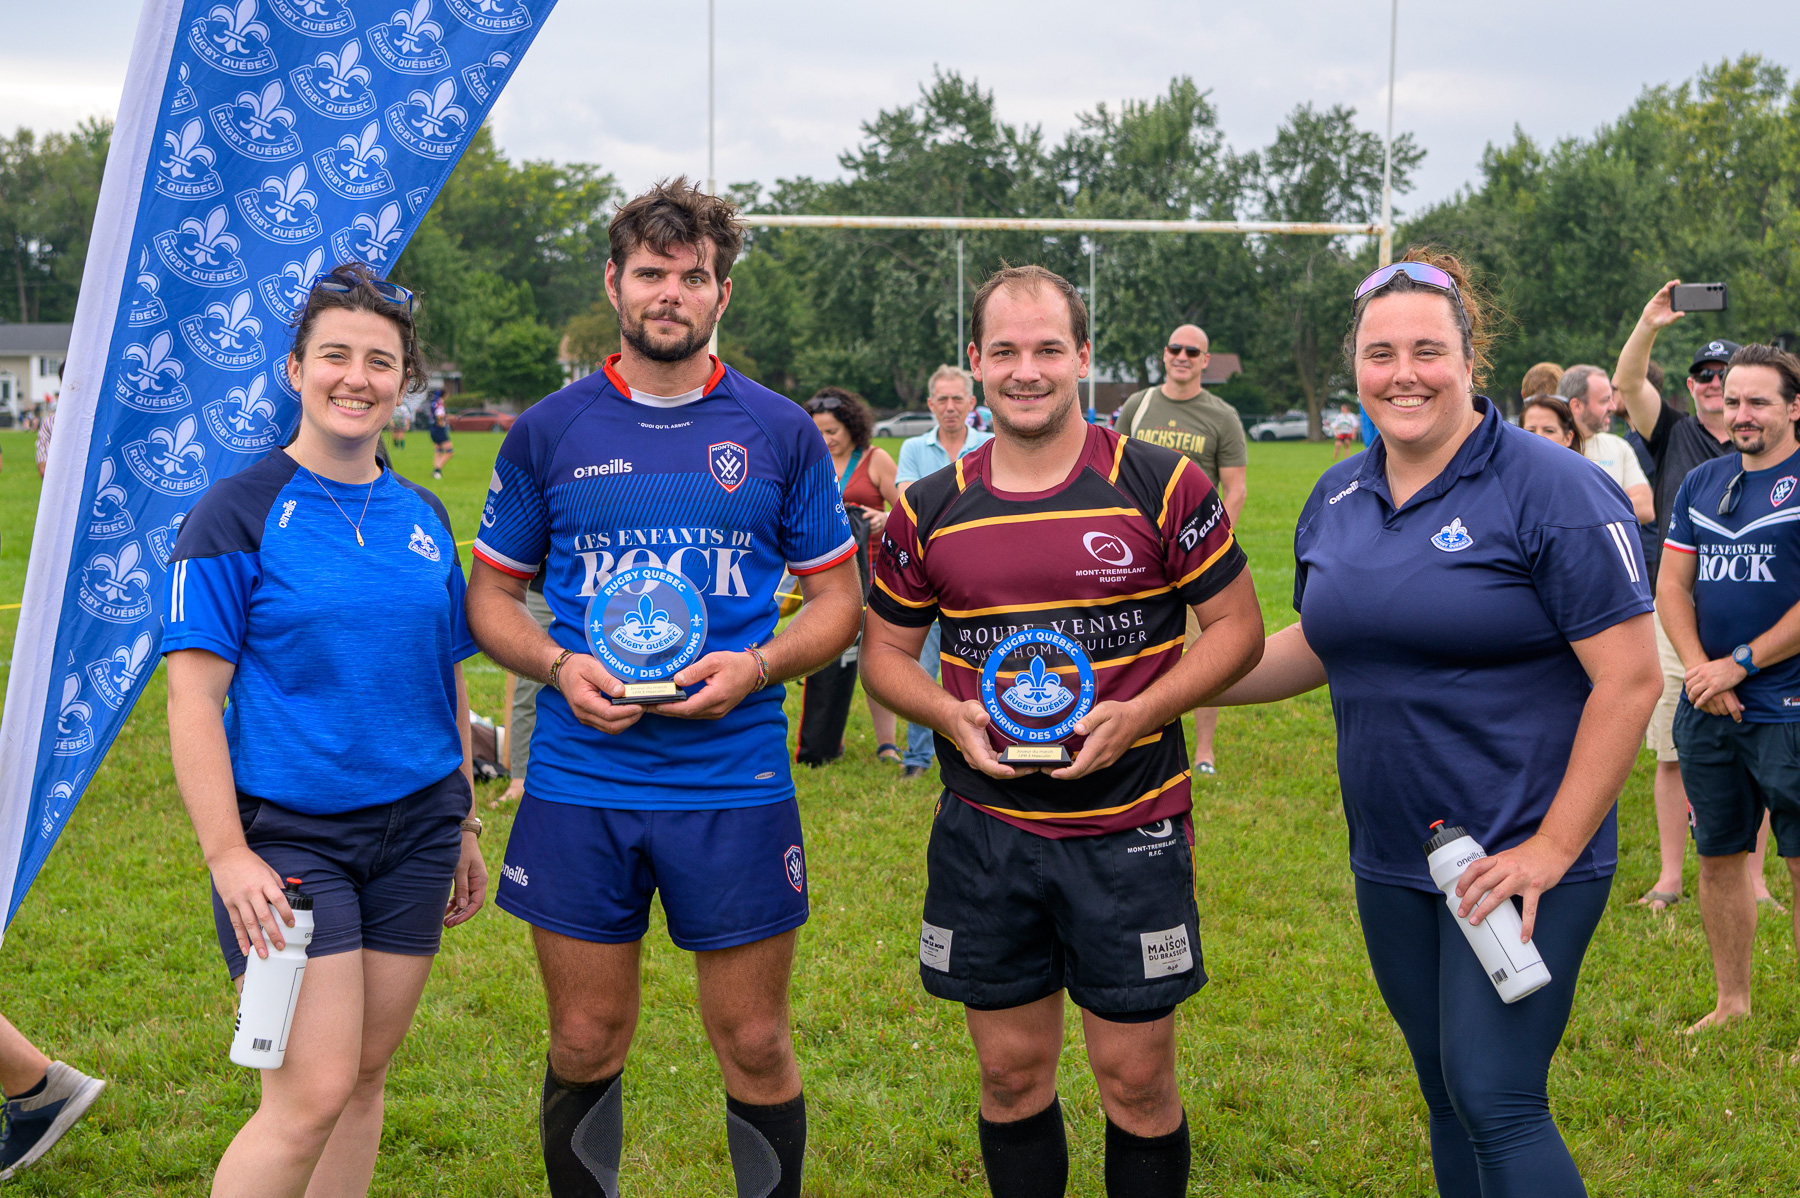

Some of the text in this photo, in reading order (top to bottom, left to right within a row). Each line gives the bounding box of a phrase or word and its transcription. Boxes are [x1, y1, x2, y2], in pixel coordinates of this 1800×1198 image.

[301, 18, 348, 32] QUÉBEC
[476, 17, 524, 28] QUÉBEC
[191, 27, 270, 70] RUGBY QUÉBEC
[372, 31, 443, 69] RUGBY QUÉBEC
[296, 74, 370, 114] RUGBY QUÉBEC
[216, 112, 295, 156] RUGBY QUÉBEC
[389, 110, 418, 144] RUGBY
[167, 181, 216, 195] QUÉBEC
[319, 156, 386, 194] RUGBY QUÉBEC
[242, 197, 316, 238] RUGBY QUÉBEC
[160, 238, 240, 282] RUGBY QUÉBEC
[264, 282, 289, 315] RUGBY
[185, 322, 260, 365] RUGBY QUÉBEC
[134, 394, 184, 407] QUÉBEC
[208, 408, 276, 448] RUGBY QUÉBEC
[1136, 429, 1206, 454] DACHSTEIN
[129, 448, 202, 491] RUGBY QUÉBEC
[618, 528, 724, 546] ENFANTS
[1179, 498, 1224, 551] David
[1710, 543, 1756, 555] ENFANTS
[1760, 544, 1777, 554] DU
[604, 569, 687, 596] RUGBY QUEBEC
[1075, 567, 1146, 576] MONT-TREMBLANT
[1698, 554, 1777, 583] ROCK
[102, 603, 147, 618] QUÉBEC
[1050, 609, 1143, 635] VENISE
[615, 630, 679, 650] RUGBY QUÉBEC
[998, 631, 1079, 657] RUGBY QUEBEC
[595, 632, 701, 678] TOURNOI DES RÉGIONS
[93, 667, 117, 700] RUGBY
[1006, 694, 1069, 713] RUGBY QUÉBEC
[987, 697, 1091, 740] TOURNOI DES RÉGIONS
[1127, 838, 1177, 853] MONT-TREMBLANT
[1147, 936, 1186, 954] MAISON
[1160, 946, 1187, 960] BRASSEUR
